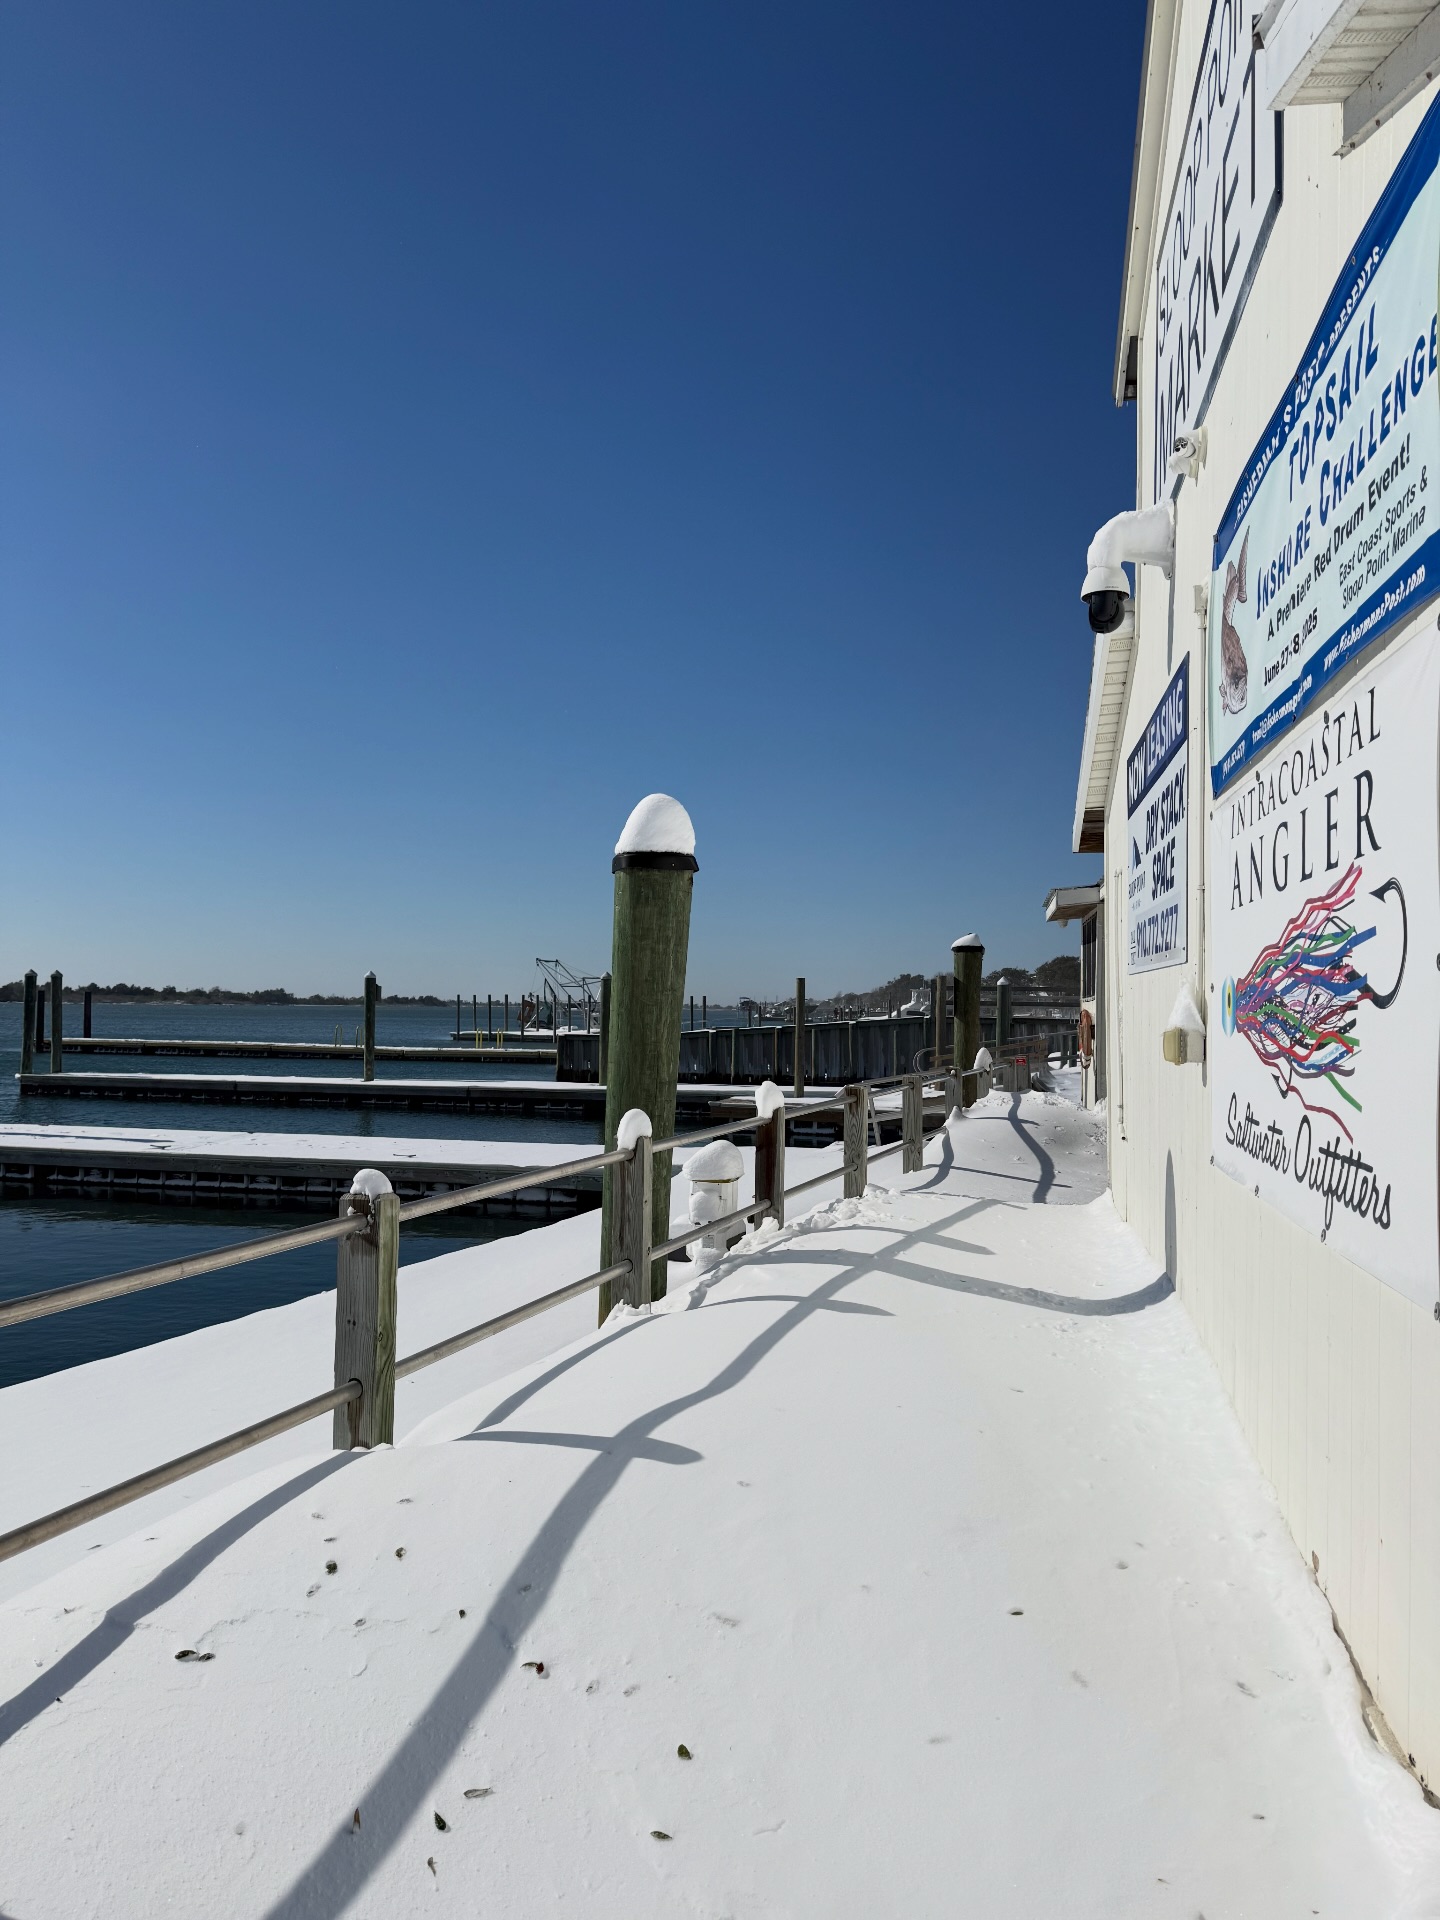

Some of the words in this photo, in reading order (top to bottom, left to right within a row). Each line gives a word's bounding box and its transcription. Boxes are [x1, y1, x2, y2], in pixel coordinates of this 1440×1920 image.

[1158, 46, 1256, 501] MARKET
[1159, 117, 1203, 357] SLOOP
[1257, 504, 1311, 620] INSHORE
[1319, 312, 1437, 527] CHALLENGE
[1289, 300, 1379, 503] TOPSAIL
[1267, 617, 1275, 641] A
[1314, 537, 1332, 583] Red
[1333, 502, 1365, 556] Drum
[1368, 431, 1411, 513] Event!
[1339, 548, 1355, 588] East
[1357, 518, 1382, 564] Coast
[1384, 481, 1416, 534] Sports
[1419, 464, 1428, 489] &
[1342, 574, 1363, 609] Sloop
[1366, 541, 1389, 584] Point
[1391, 504, 1426, 558] Marina
[1128, 741, 1146, 809] NOW
[1147, 678, 1184, 779] LEASING
[1264, 660, 1280, 687] June
[1145, 796, 1160, 856] DRY
[1160, 763, 1186, 841] STACK
[1230, 685, 1381, 840] INTRACOASTAL
[1152, 835, 1176, 901] SPACE
[1230, 769, 1382, 911] ANGLER
[1136, 903, 1178, 958] 910.772.9277
[1225, 1091, 1292, 1175] Saltwater
[1294, 1114, 1391, 1231] Outfitters
